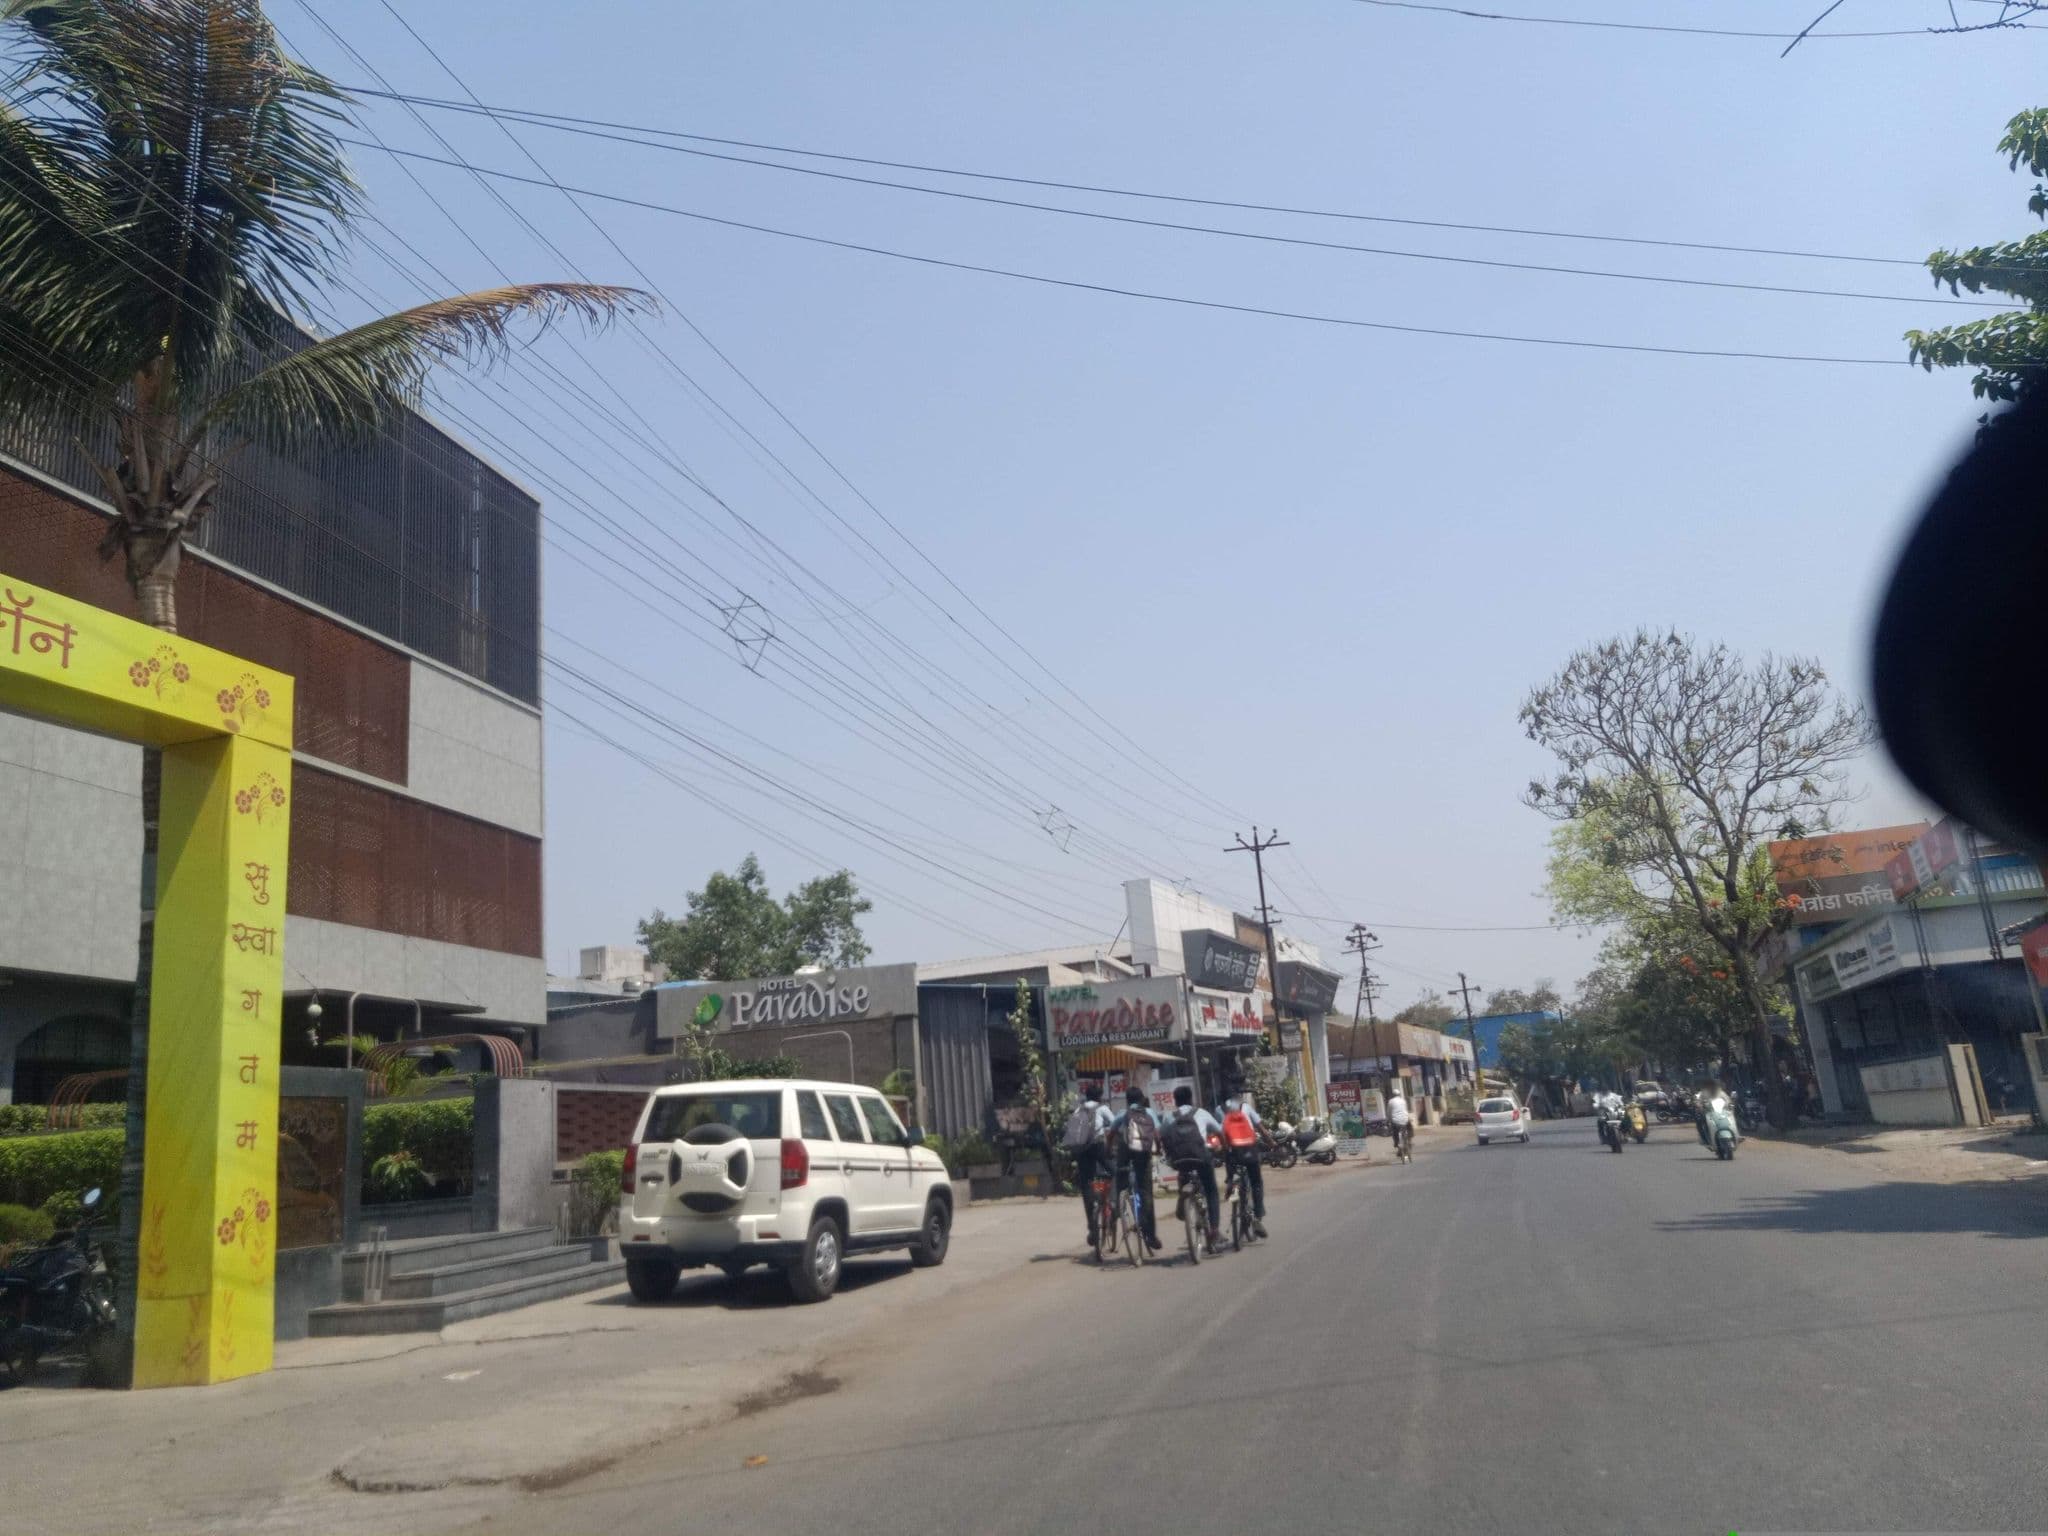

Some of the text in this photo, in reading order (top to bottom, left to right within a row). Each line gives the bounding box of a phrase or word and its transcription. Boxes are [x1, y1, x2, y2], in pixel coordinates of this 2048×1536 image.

[0, 588, 78, 669] ॉन
[731, 975, 872, 1026] Paradise
[758, 978, 802, 992] HOTEL
[1050, 997, 1175, 1037] Paradise
[1061, 1028, 1165, 1046] LODGING & RESTAURANT
